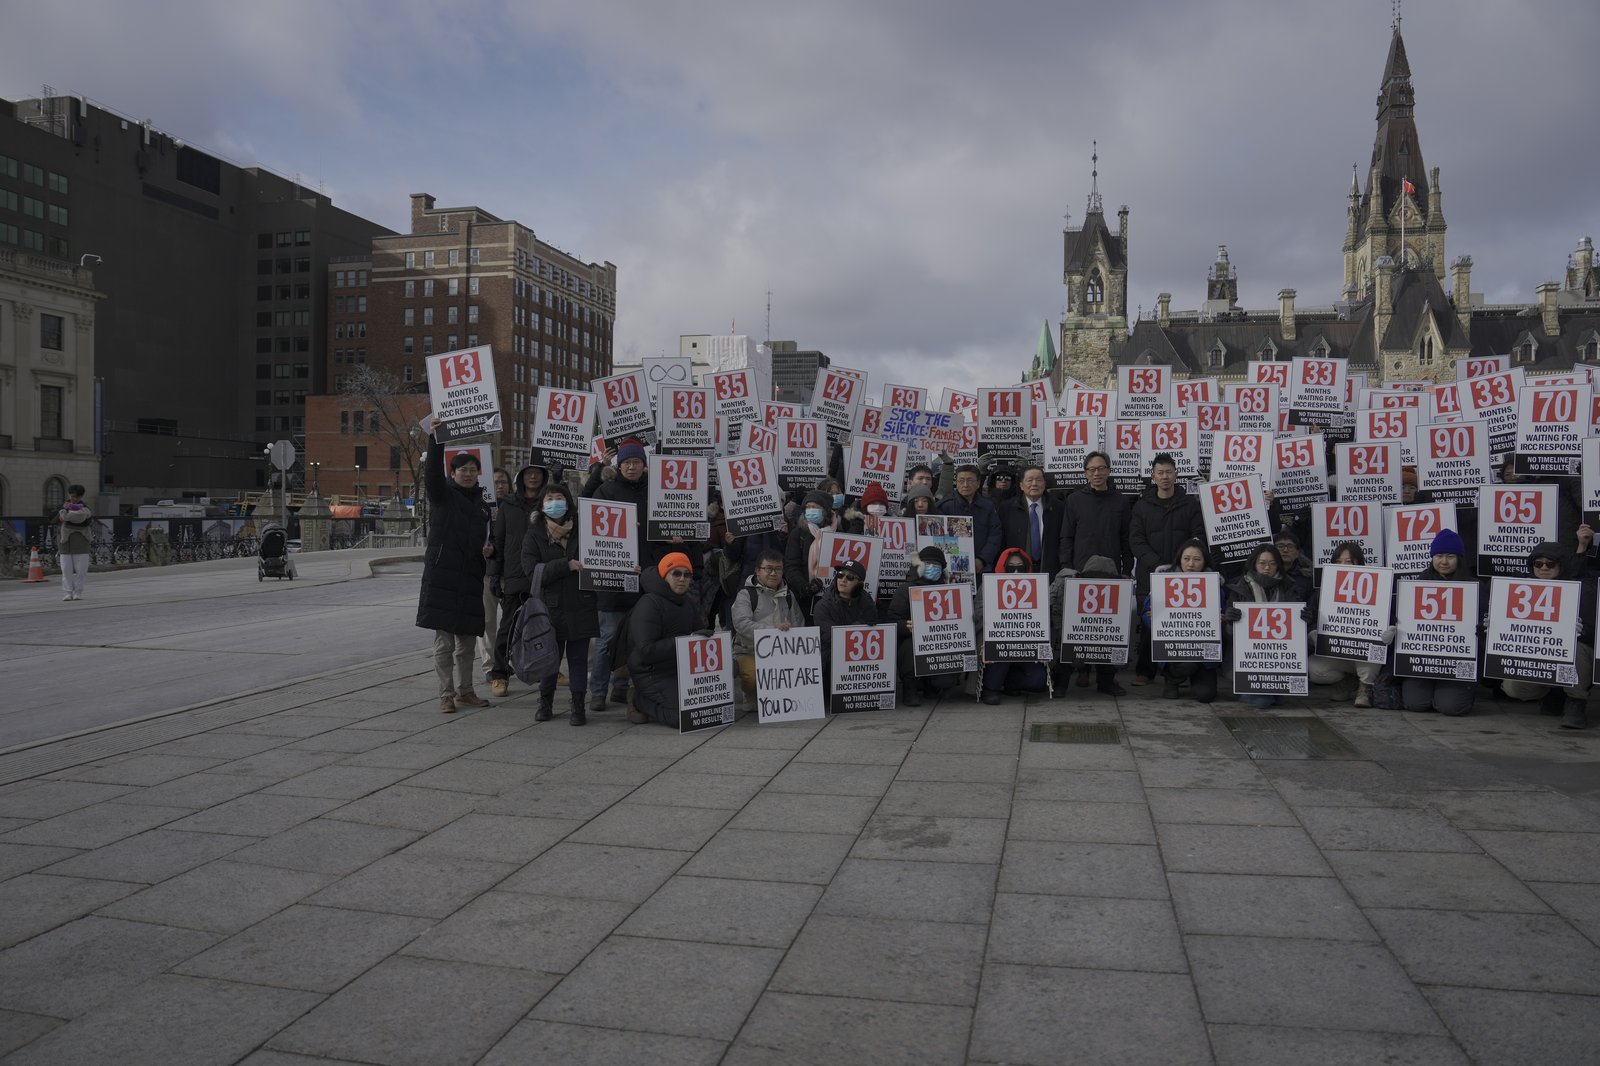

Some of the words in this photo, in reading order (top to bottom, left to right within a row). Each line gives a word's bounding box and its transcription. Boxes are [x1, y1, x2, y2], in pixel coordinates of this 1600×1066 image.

[445, 353, 476, 386] 13
[1261, 365, 1283, 387] 25
[1306, 362, 1332, 385] 33
[447, 385, 479, 398] MONTHS
[607, 376, 636, 407] 30
[718, 374, 746, 399] 35
[826, 377, 850, 402] 42
[1133, 370, 1157, 393] 53
[1182, 383, 1205, 402] 31
[1476, 376, 1510, 407] 33
[437, 409, 453, 419] IRCC
[454, 401, 493, 415] RESPONSE
[441, 396, 471, 409] WAITING
[473, 393, 488, 402] FOR
[551, 394, 581, 422] 30
[676, 392, 703, 418] 36
[894, 390, 916, 408] 39
[993, 393, 1016, 416] 11
[1080, 394, 1103, 416] 15
[1239, 389, 1265, 412] 68
[1539, 391, 1572, 421] 70
[890, 408, 920, 423] STOP
[925, 413, 951, 427] THE
[1201, 406, 1226, 429] 34
[1373, 412, 1403, 438] 55
[790, 424, 814, 447] 40
[1058, 421, 1084, 445] 71
[1156, 422, 1182, 449] 63
[1434, 428, 1469, 457] 90
[865, 444, 893, 470] 54
[1228, 436, 1257, 461] 68
[1281, 441, 1310, 468] 55
[1353, 448, 1384, 474] 34
[1428, 469, 1461, 477] WAITING
[1464, 467, 1480, 475] FOR
[1436, 459, 1470, 468] MONTHS
[665, 460, 696, 489] 34
[732, 460, 765, 487] 38
[1423, 479, 1440, 487] IRCC
[1441, 476, 1485, 485] RESPONSE
[731, 496, 758, 507] WAITING
[759, 494, 772, 502] FOR
[736, 487, 764, 497] MONTHS
[1216, 481, 1248, 513] 39
[729, 507, 743, 516] IRCC
[743, 501, 777, 513] RESPONSE
[1220, 512, 1250, 523] MONTHS
[1500, 492, 1536, 523] 65
[596, 507, 622, 537] 37
[1214, 522, 1244, 533] WAITING
[1245, 519, 1259, 527] FOR
[1330, 507, 1364, 536] 40
[1402, 509, 1436, 540] 72
[595, 540, 623, 548] MONTHS
[1212, 533, 1227, 542] IRCC
[1227, 526, 1265, 539] RESPONSE
[584, 557, 598, 565] IRCC
[599, 558, 633, 568] RESPONSE
[588, 548, 615, 557] WAITING
[836, 540, 866, 567] 42
[1002, 580, 1032, 609] 62
[1170, 578, 1202, 608] 35
[1338, 571, 1373, 604] 40
[928, 589, 958, 621] 31
[1082, 585, 1113, 614] 81
[1421, 588, 1457, 620] 51
[1512, 585, 1555, 620] 34
[1080, 616, 1112, 624] MONTHS
[1328, 615, 1360, 625] WAITING
[1362, 618, 1378, 626] FOR
[1336, 606, 1370, 616] MONTHS
[929, 623, 958, 632] MONTHS
[989, 630, 1004, 638] IRCC
[1174, 629, 1215, 637] RESPONSE
[1253, 608, 1287, 639] 43
[1322, 623, 1339, 632] IRCC
[1339, 625, 1382, 637] RESPONSE
[1417, 623, 1455, 632] MONTHS
[1510, 623, 1552, 634] MONTHS
[756, 636, 820, 658] CANADA
[849, 631, 880, 660] 36
[918, 643, 933, 652] IRCC
[934, 640, 971, 650] RESPONSE
[922, 633, 951, 642] WAITING
[953, 631, 966, 639] FOR
[1401, 642, 1420, 651] IRCC
[1421, 643, 1470, 653] RESPONSE
[1407, 633, 1444, 642] WAITING
[1447, 634, 1465, 643] FOR
[1499, 633, 1540, 644] WAITING
[1542, 636, 1562, 646] FOR
[692, 639, 718, 673] 18
[1492, 642, 1513, 652] IRCC
[1514, 644, 1568, 657] RESPONSE
[848, 663, 879, 672] MONTHS
[1258, 661, 1301, 669] RESPONSE
[1500, 657, 1512, 665] NO
[1513, 659, 1556, 670] TIMELINES
[1503, 666, 1515, 675] NO
[1516, 668, 1552, 679] RESULTS
[694, 674, 719, 685] MONTHS
[757, 668, 793, 690] WHAT
[795, 668, 819, 686] ARE
[836, 683, 851, 691] IRCC
[852, 680, 890, 690] RESPONSE
[841, 673, 870, 681] WAITING
[684, 697, 697, 707] IRCC
[698, 691, 730, 704] RESPONSE
[687, 684, 713, 696] WAITING
[715, 682, 726, 691] FOR
[759, 697, 780, 718] YOU
